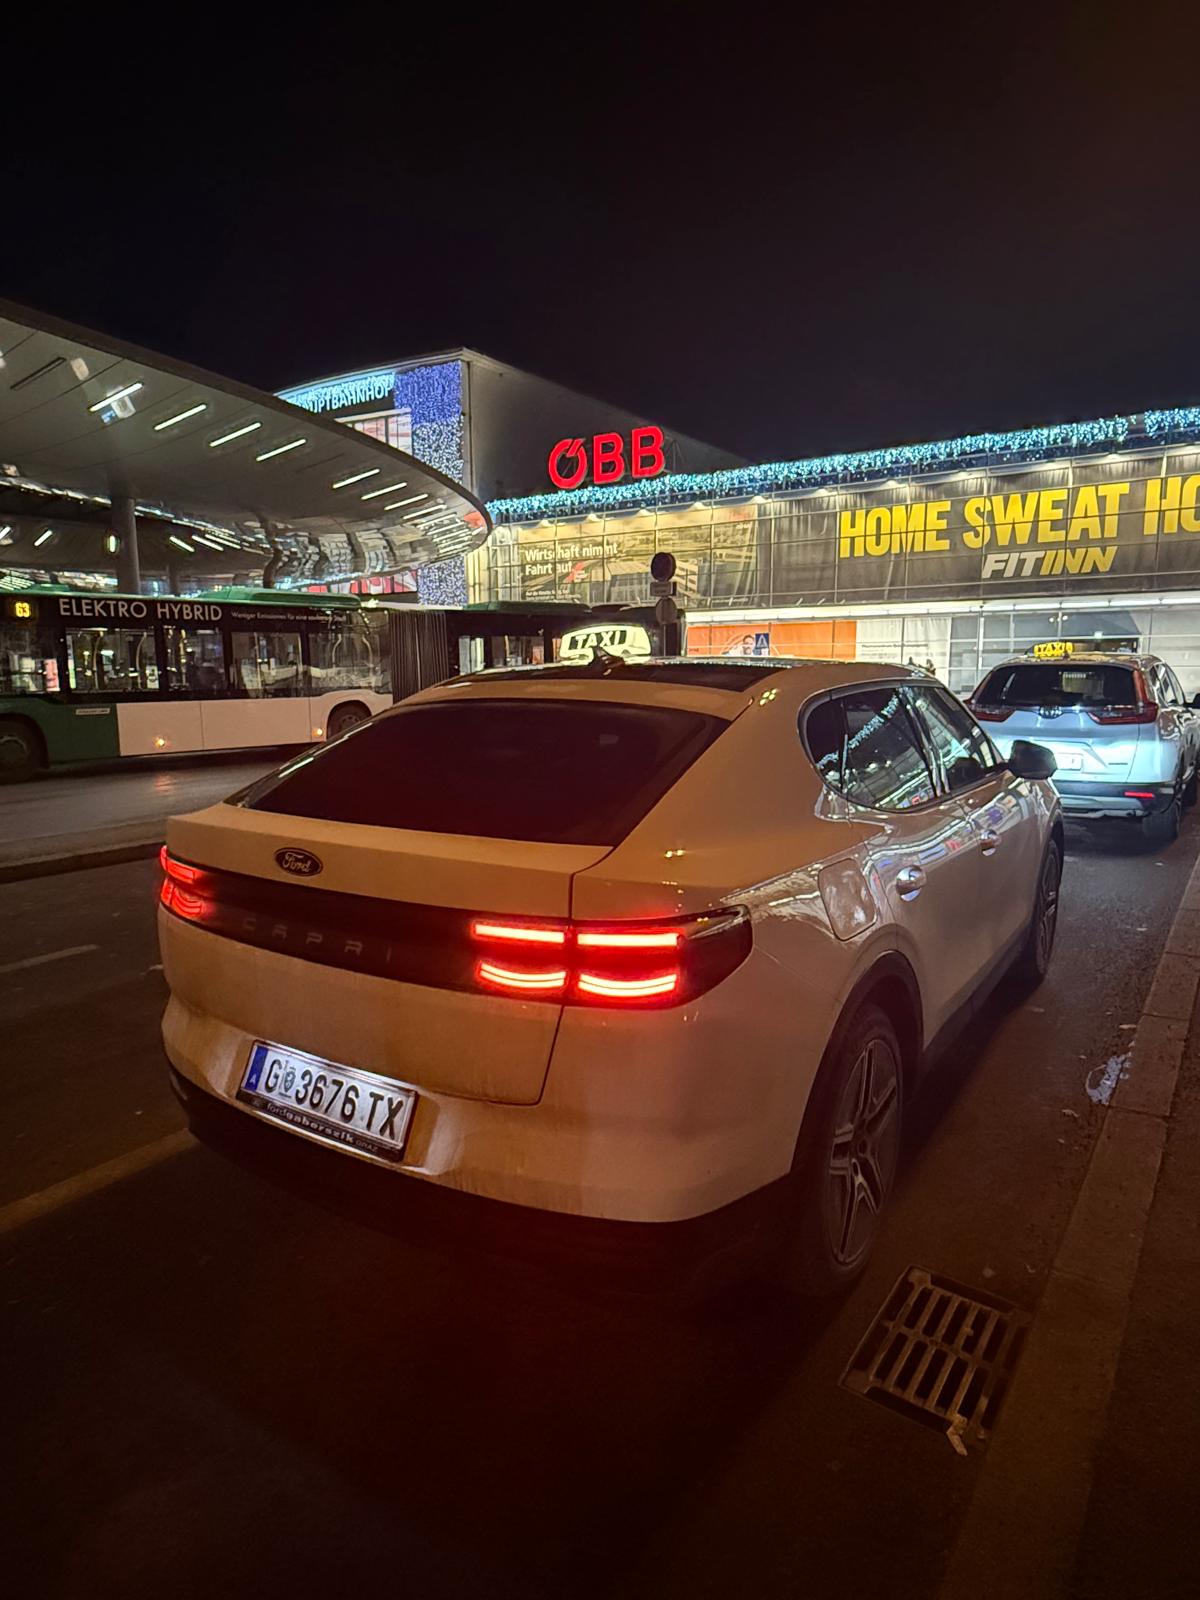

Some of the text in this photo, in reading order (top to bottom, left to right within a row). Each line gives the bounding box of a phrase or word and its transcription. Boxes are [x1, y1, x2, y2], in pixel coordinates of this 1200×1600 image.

[547, 425, 667, 490] ÖBB
[838, 500, 952, 558] HOME
[963, 482, 1130, 550] SWEAT
[525, 561, 573, 576] Fahrt auf
[15, 602, 31, 618] 63
[59, 598, 223, 621] ELEKTRO HYBRID
[575, 630, 621, 649] TAXI
[1038, 642, 1066, 657] TAXI
[282, 852, 312, 873] Ford
[244, 919, 392, 961] CAPRI
[295, 1069, 360, 1124] 3676
[365, 1092, 405, 1141] TX
